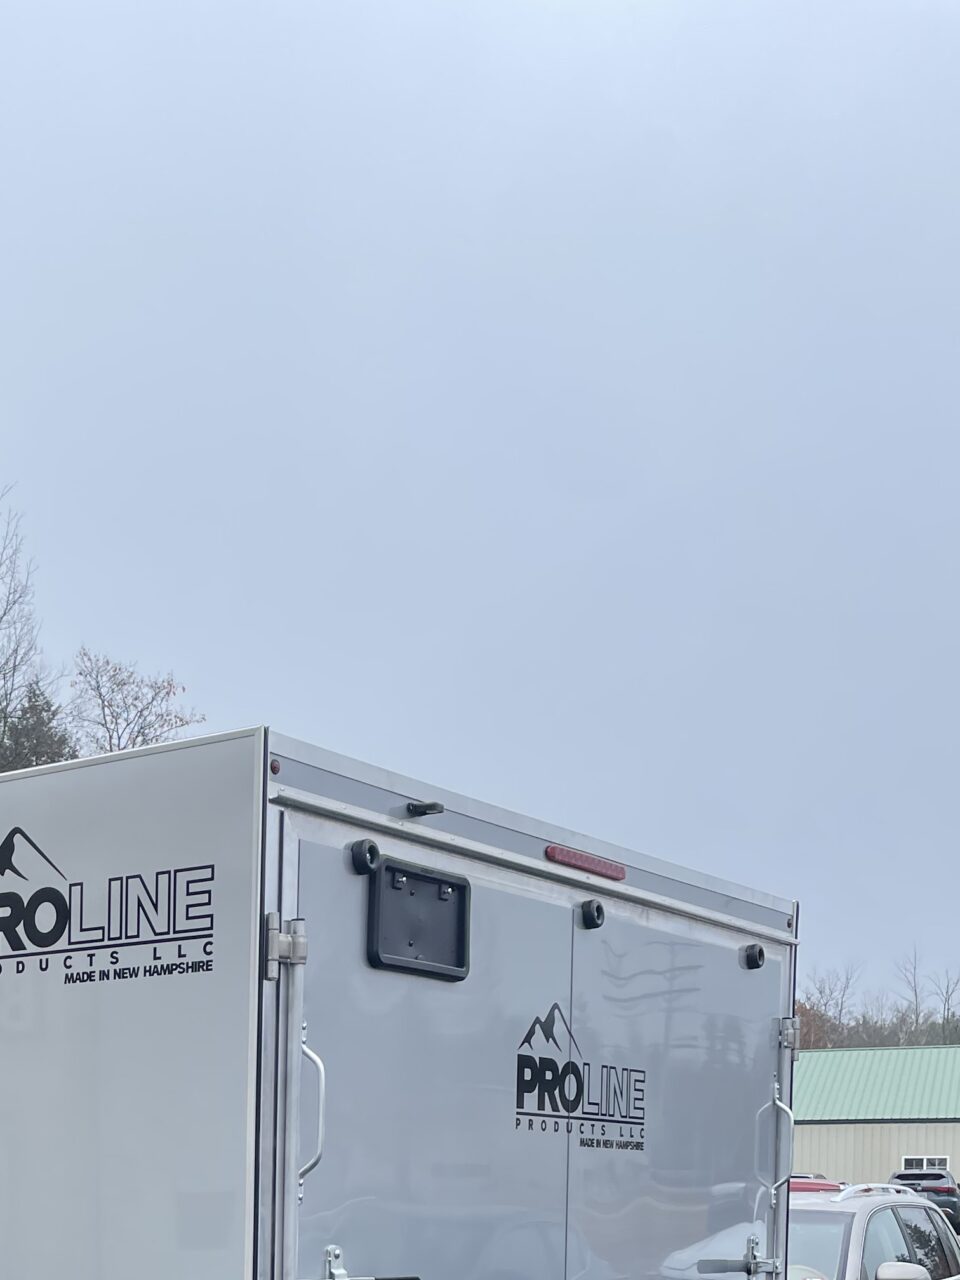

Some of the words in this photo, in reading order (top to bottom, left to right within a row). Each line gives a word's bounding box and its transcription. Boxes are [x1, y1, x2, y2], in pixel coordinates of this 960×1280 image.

[152, 941, 214, 961] LLC
[64, 971, 96, 984] MADE
[98, 969, 111, 981] IN
[113, 966, 141, 980] NEW
[143, 960, 214, 978] HAMPSHIRE
[515, 1118, 606, 1136] PRODUCTS
[619, 1125, 645, 1139] LLC
[579, 1137, 595, 1148] MADE
[596, 1138, 602, 1148] IN
[602, 1139, 614, 1149] NEW
[615, 1139, 645, 1151] HAMPSHIRE
